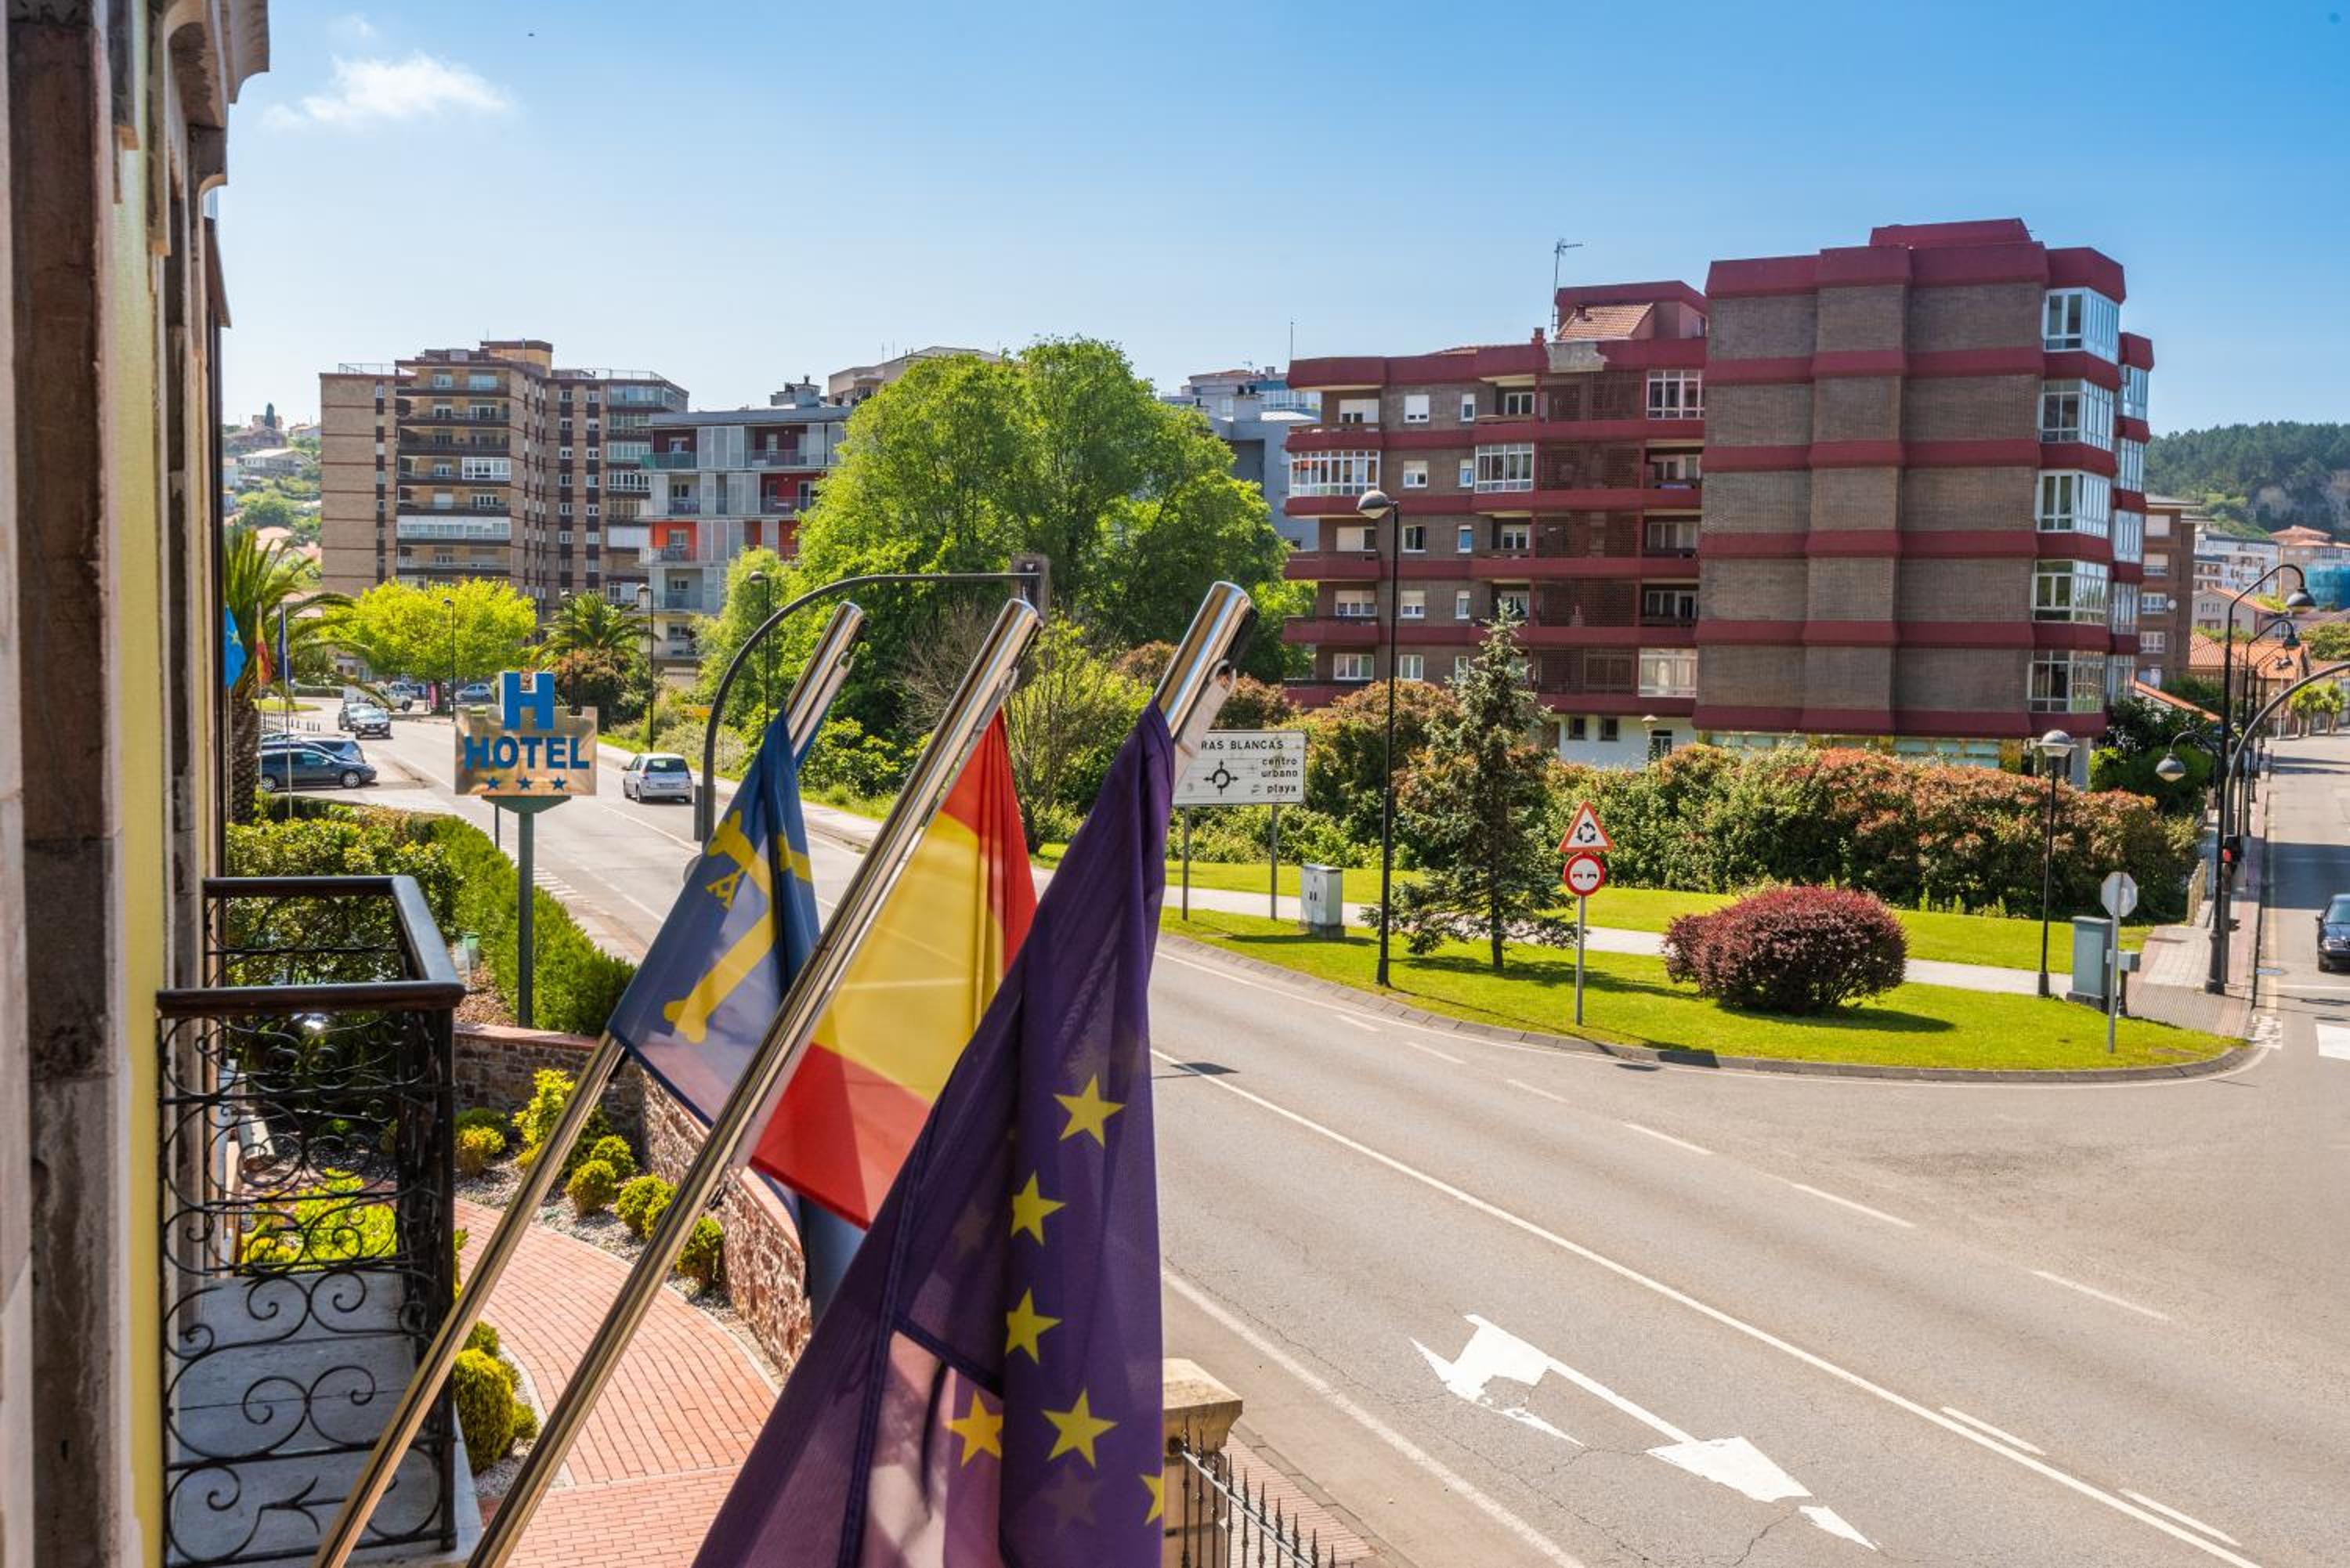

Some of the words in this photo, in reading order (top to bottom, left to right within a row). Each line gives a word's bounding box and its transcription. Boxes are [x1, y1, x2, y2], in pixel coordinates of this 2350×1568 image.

[502, 670, 555, 731] H
[462, 735, 590, 770] HOTEL
[1201, 740, 1224, 750] RAS
[1230, 740, 1284, 750] BLANCAS
[1267, 784, 1296, 793] playa
